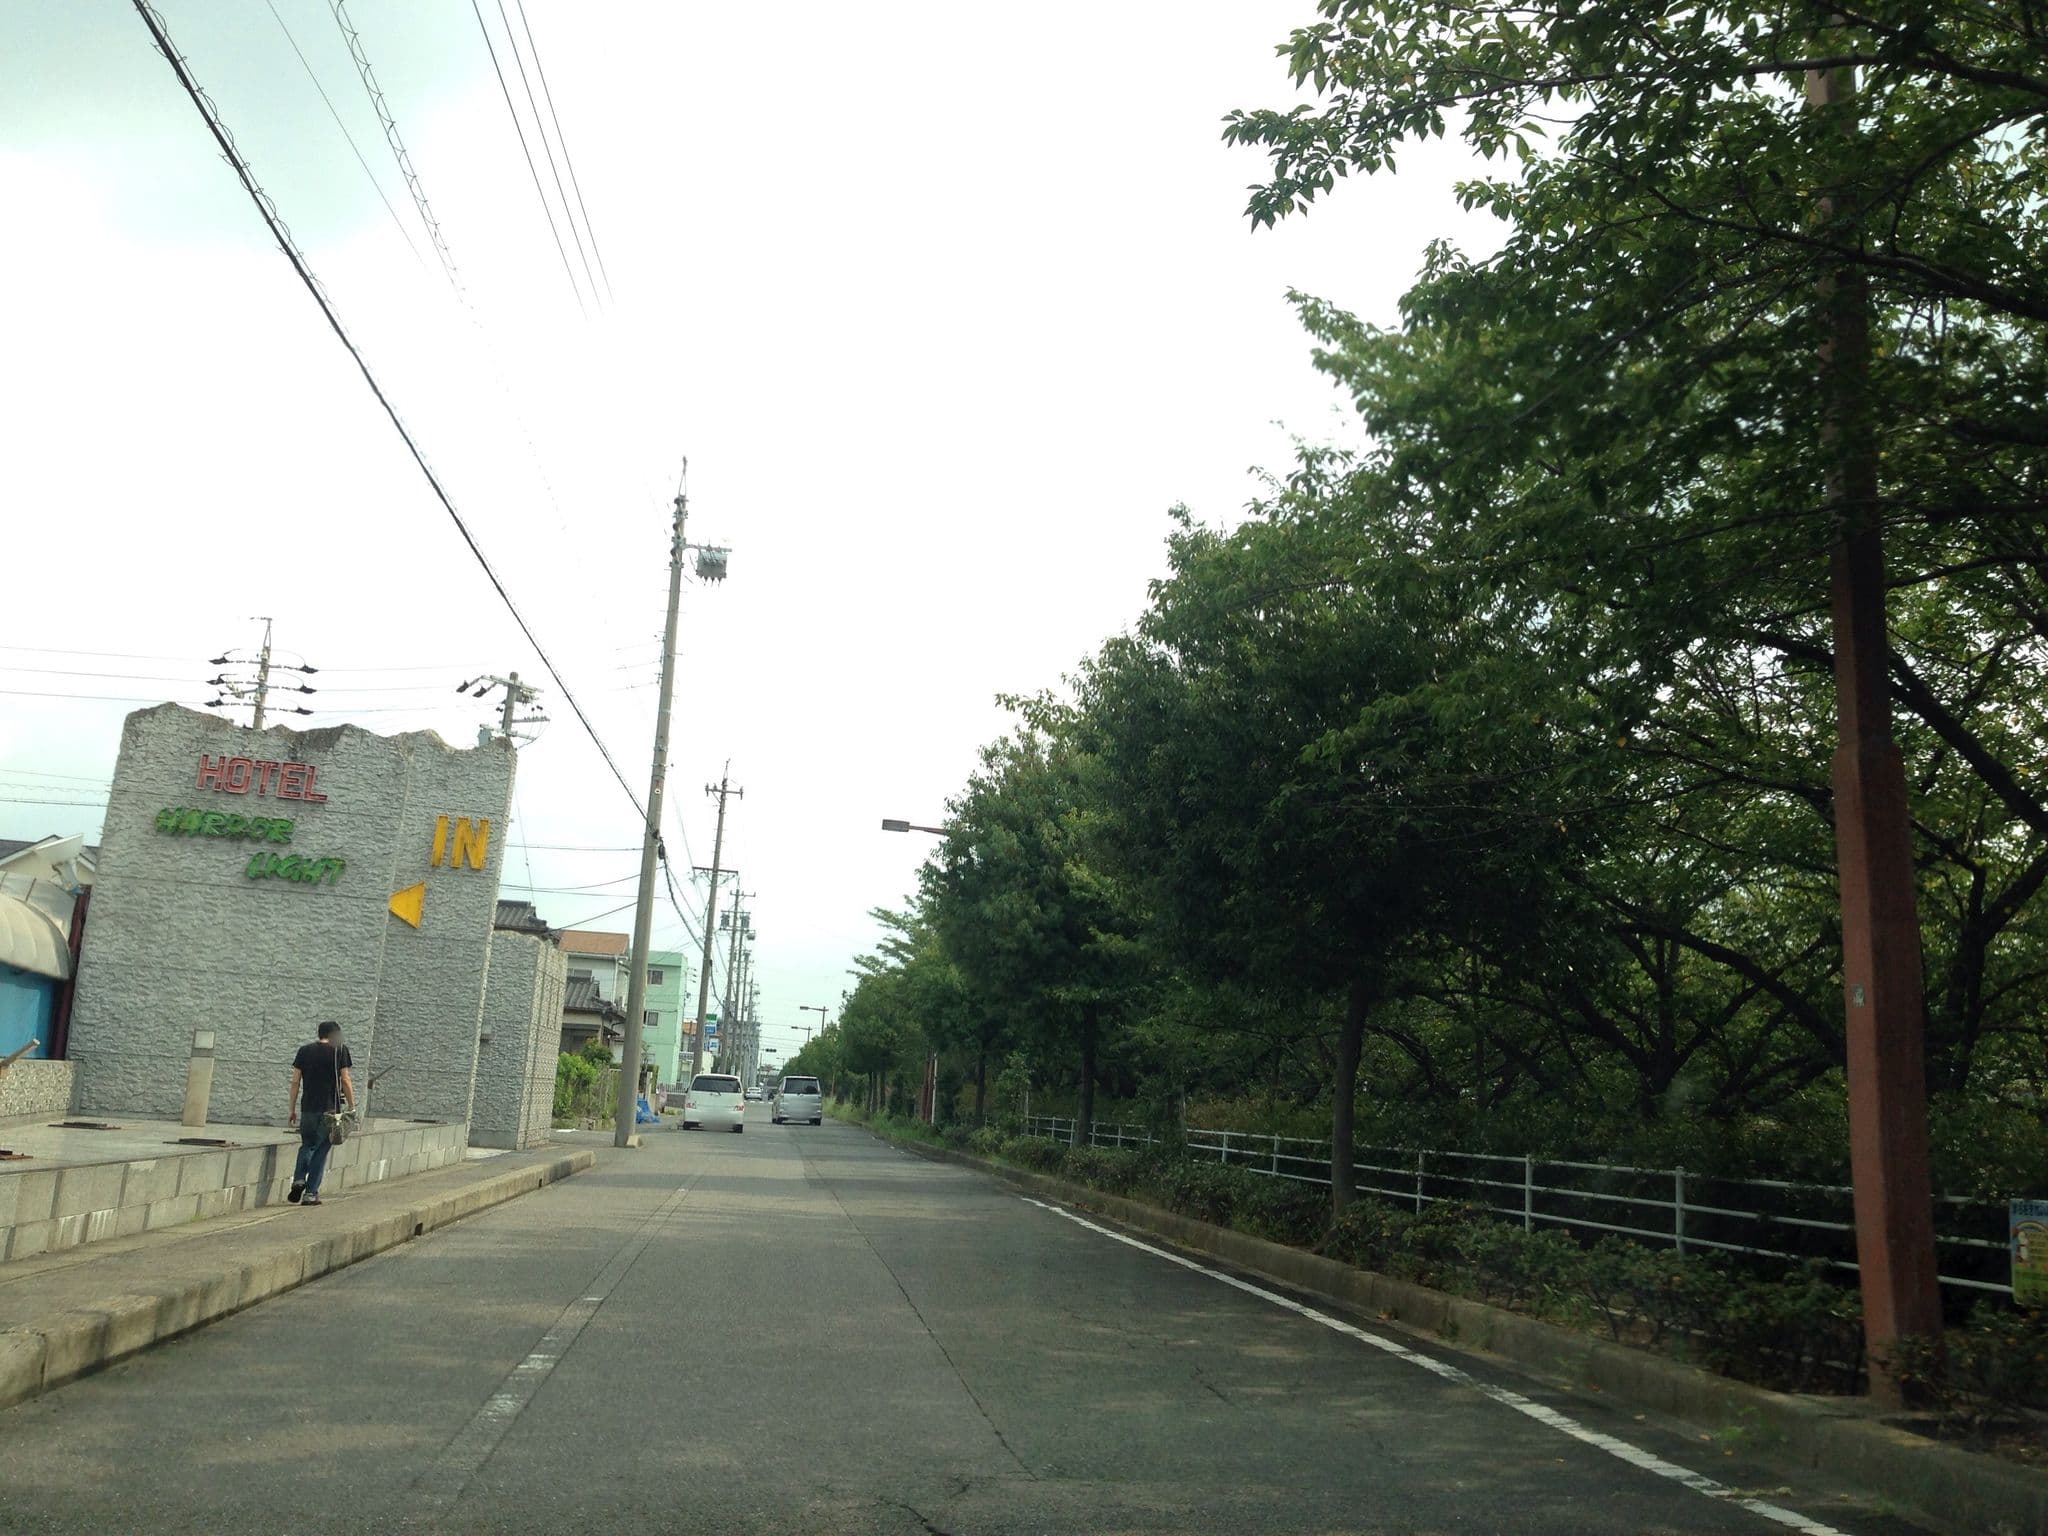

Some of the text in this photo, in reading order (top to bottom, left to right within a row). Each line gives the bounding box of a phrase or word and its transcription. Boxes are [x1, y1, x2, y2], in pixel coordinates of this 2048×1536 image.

[195, 753, 328, 803] HOTEL
[431, 814, 491, 871] IN
[245, 851, 347, 886] LIGHT
